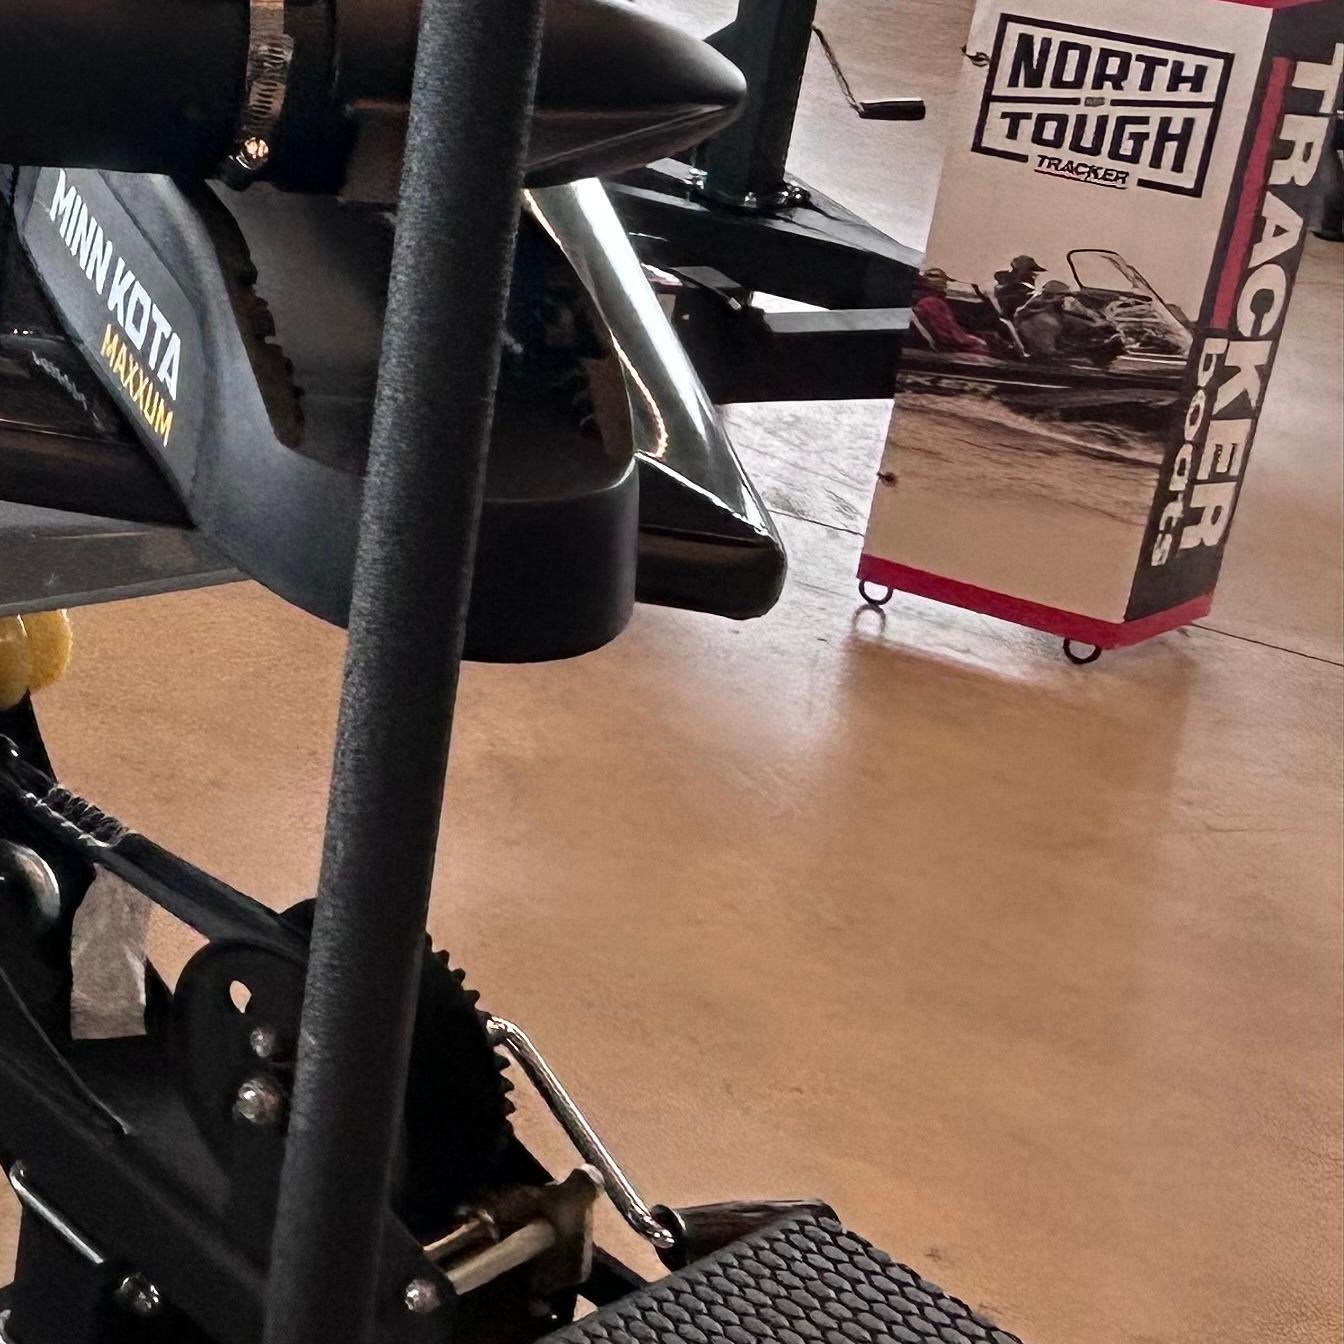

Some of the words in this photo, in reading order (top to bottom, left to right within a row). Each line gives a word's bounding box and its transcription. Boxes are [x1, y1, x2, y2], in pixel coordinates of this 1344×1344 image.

[1007, 32, 1209, 94] NORTH
[1000, 111, 1196, 174] TOUGH
[1036, 154, 1130, 185] TRACKER
[49, 167, 113, 296] MINN
[107, 256, 181, 401] KOTA
[1178, 42, 1344, 550] TRACKER
[99, 322, 174, 448] MAXXUM
[1150, 337, 1229, 567] boats
